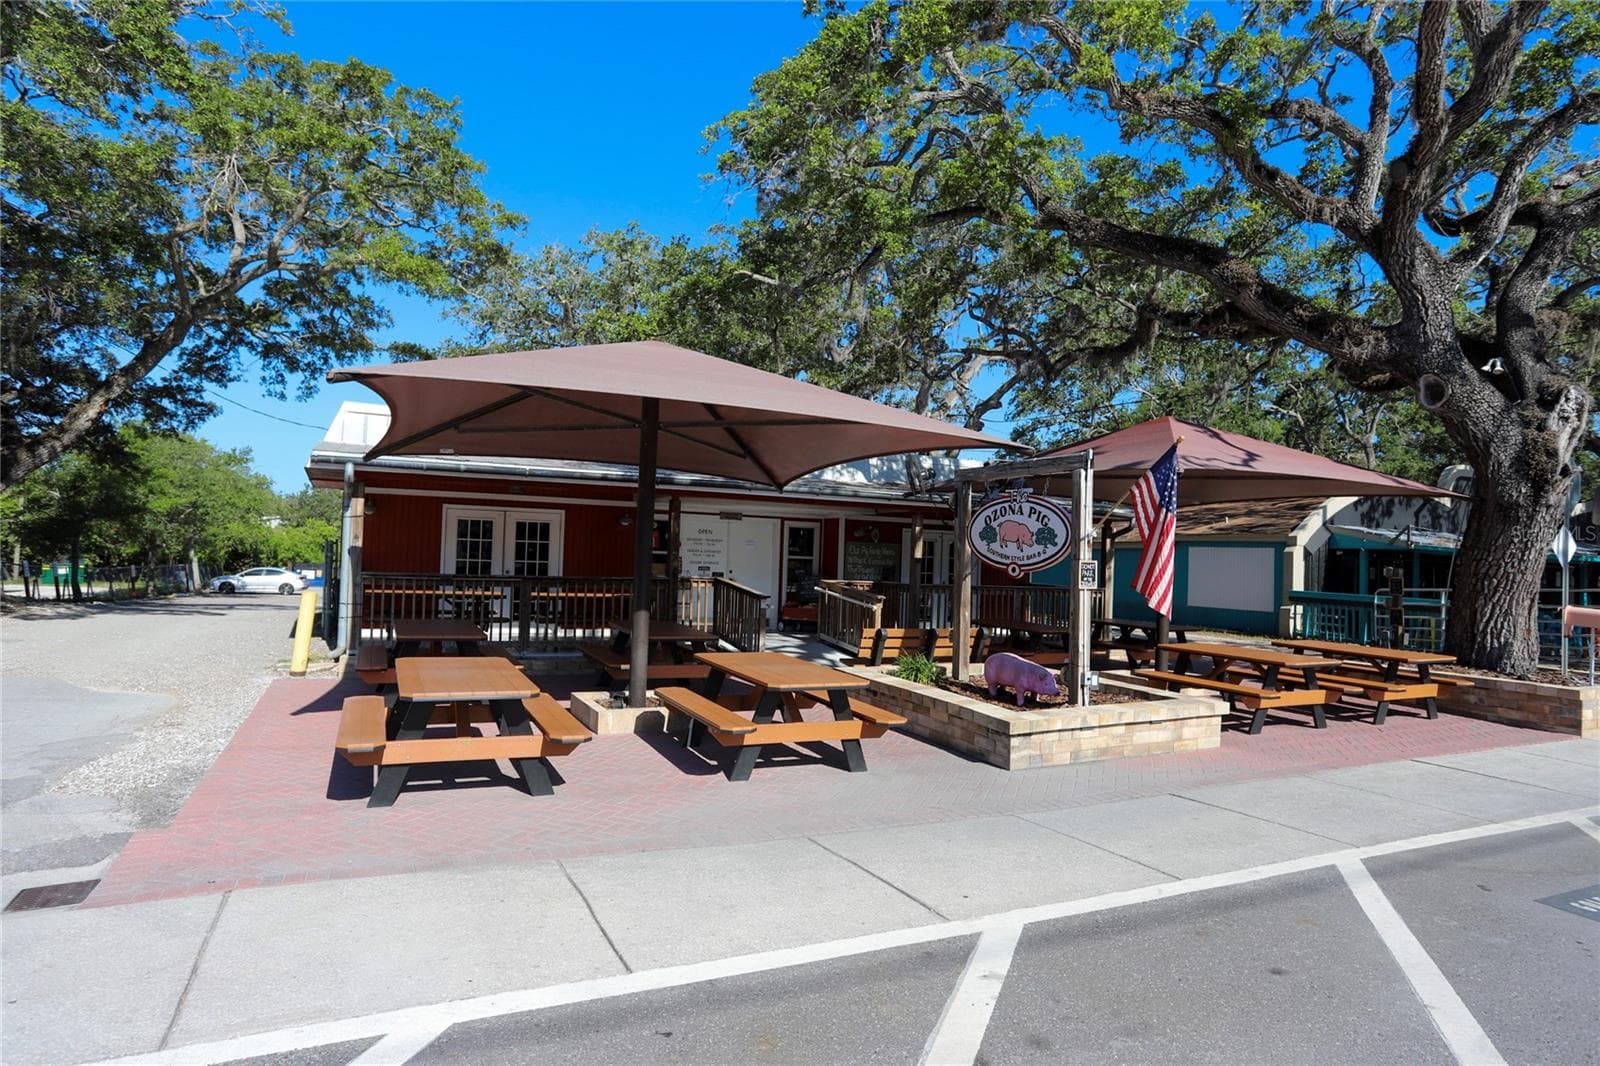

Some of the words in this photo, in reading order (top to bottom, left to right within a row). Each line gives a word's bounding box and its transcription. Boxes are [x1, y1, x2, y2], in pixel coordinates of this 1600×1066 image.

[984, 504, 1024, 526] OZONA
[1028, 506, 1050, 527] PIG
[986, 546, 1010, 560] SOUTHERN
